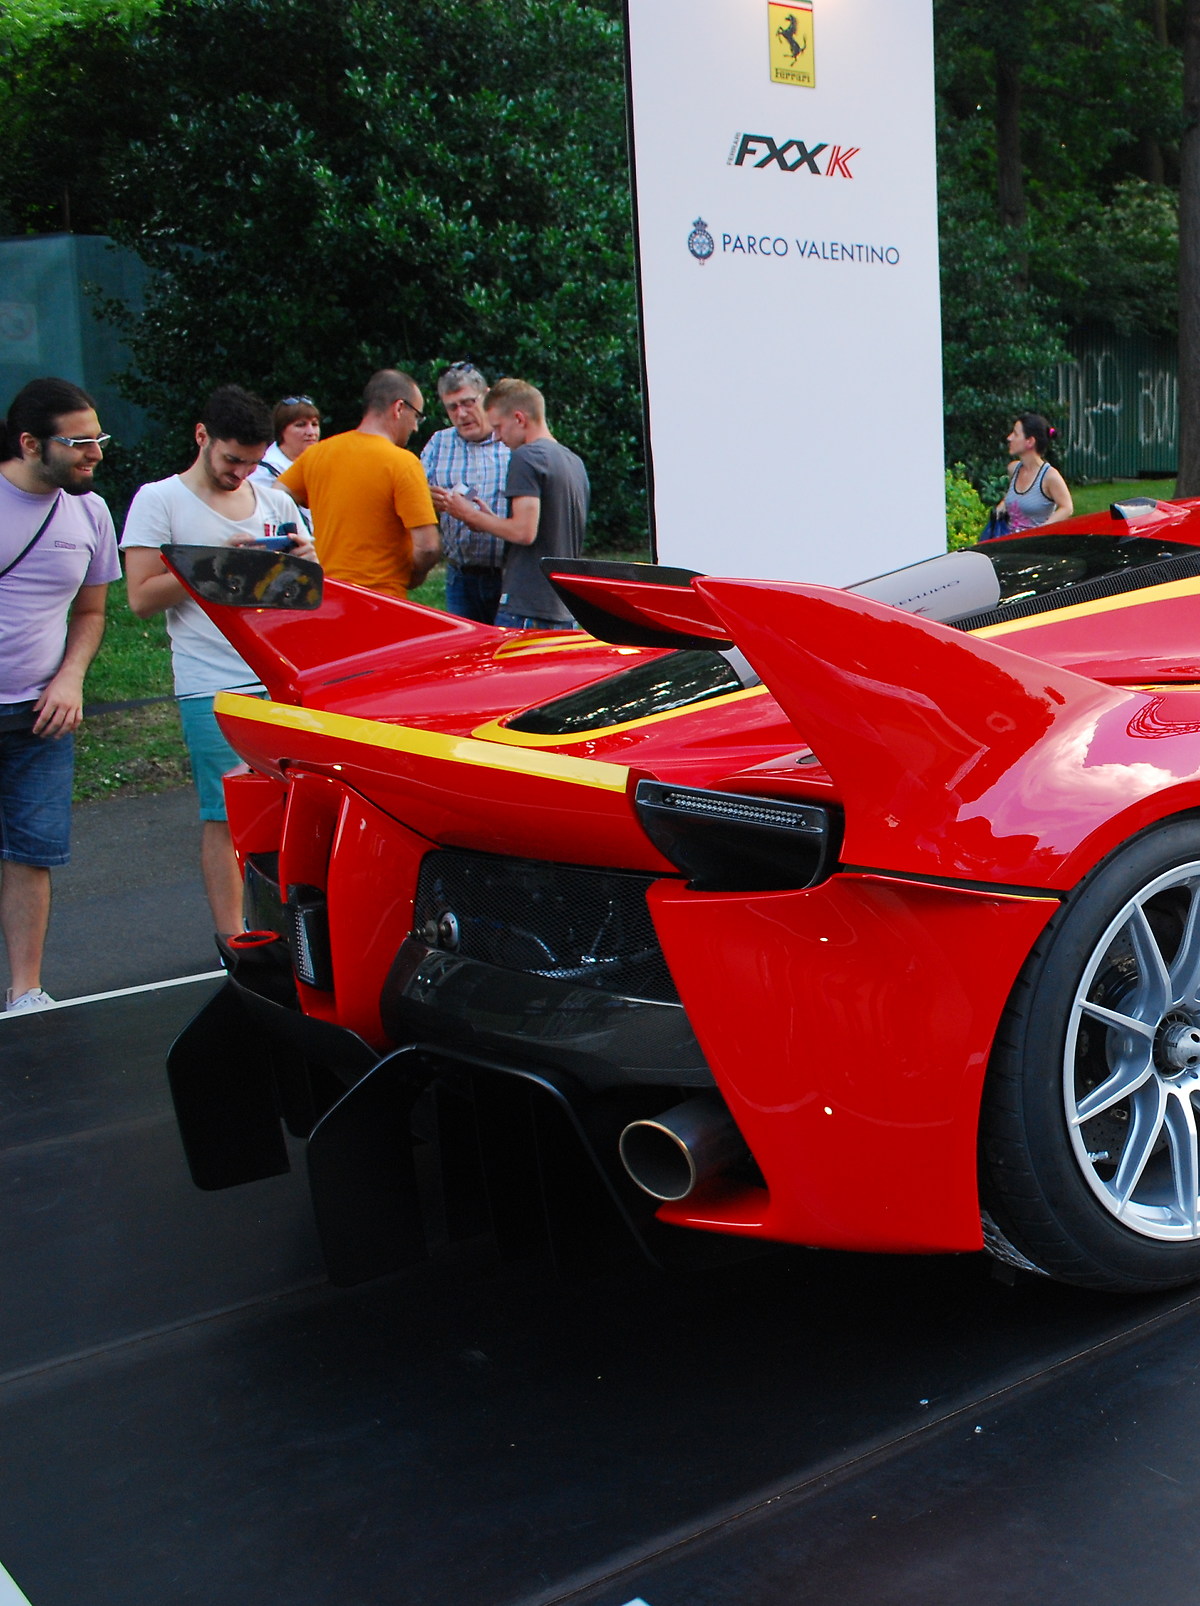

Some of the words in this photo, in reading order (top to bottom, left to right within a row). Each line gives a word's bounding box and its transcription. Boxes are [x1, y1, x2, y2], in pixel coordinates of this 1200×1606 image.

[774, 68, 810, 83] Ferrari
[722, 233, 788, 257] PARCO
[796, 239, 899, 265] VALENTINO
